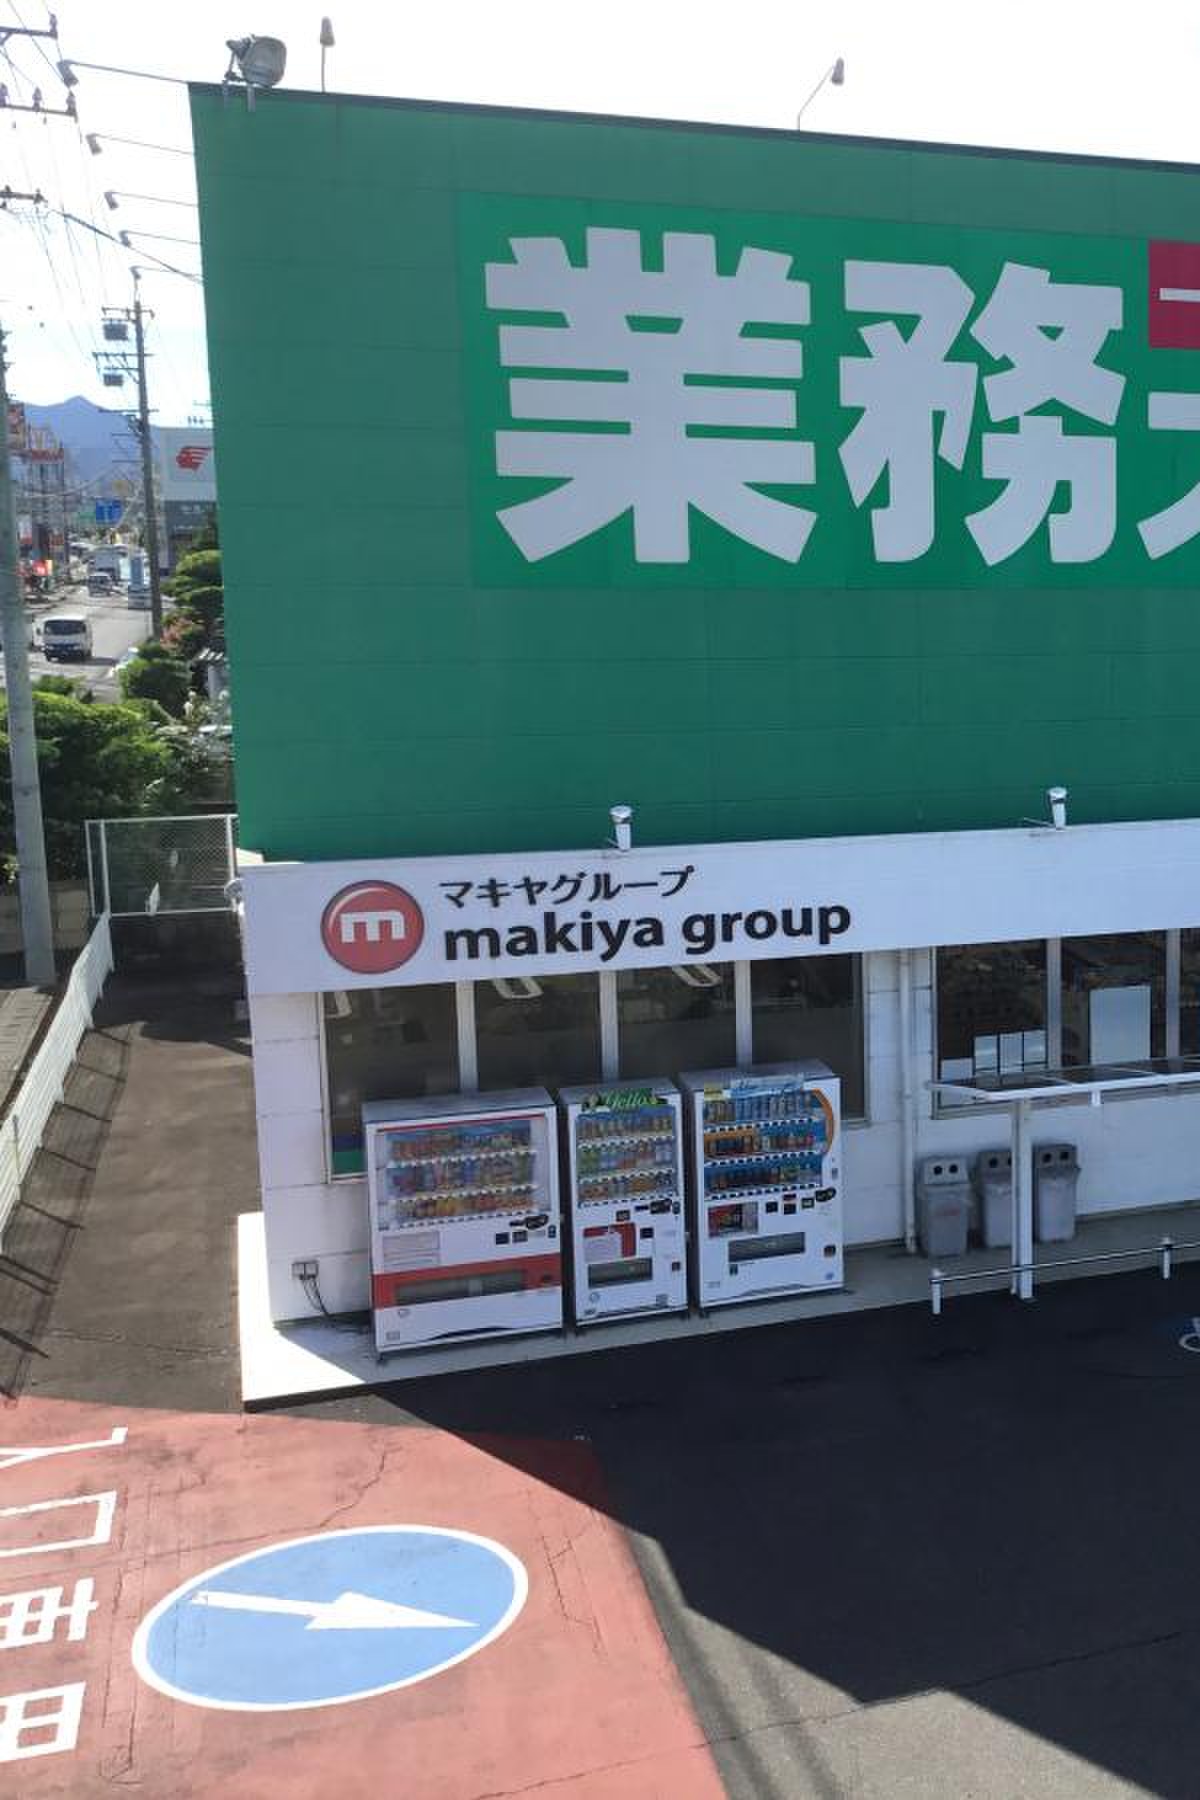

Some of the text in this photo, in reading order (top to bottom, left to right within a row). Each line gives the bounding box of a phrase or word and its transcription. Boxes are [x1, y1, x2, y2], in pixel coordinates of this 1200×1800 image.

[439, 864, 695, 908] マキヤグループ
[341, 911, 406, 943] m
[445, 905, 852, 961] makiya group
